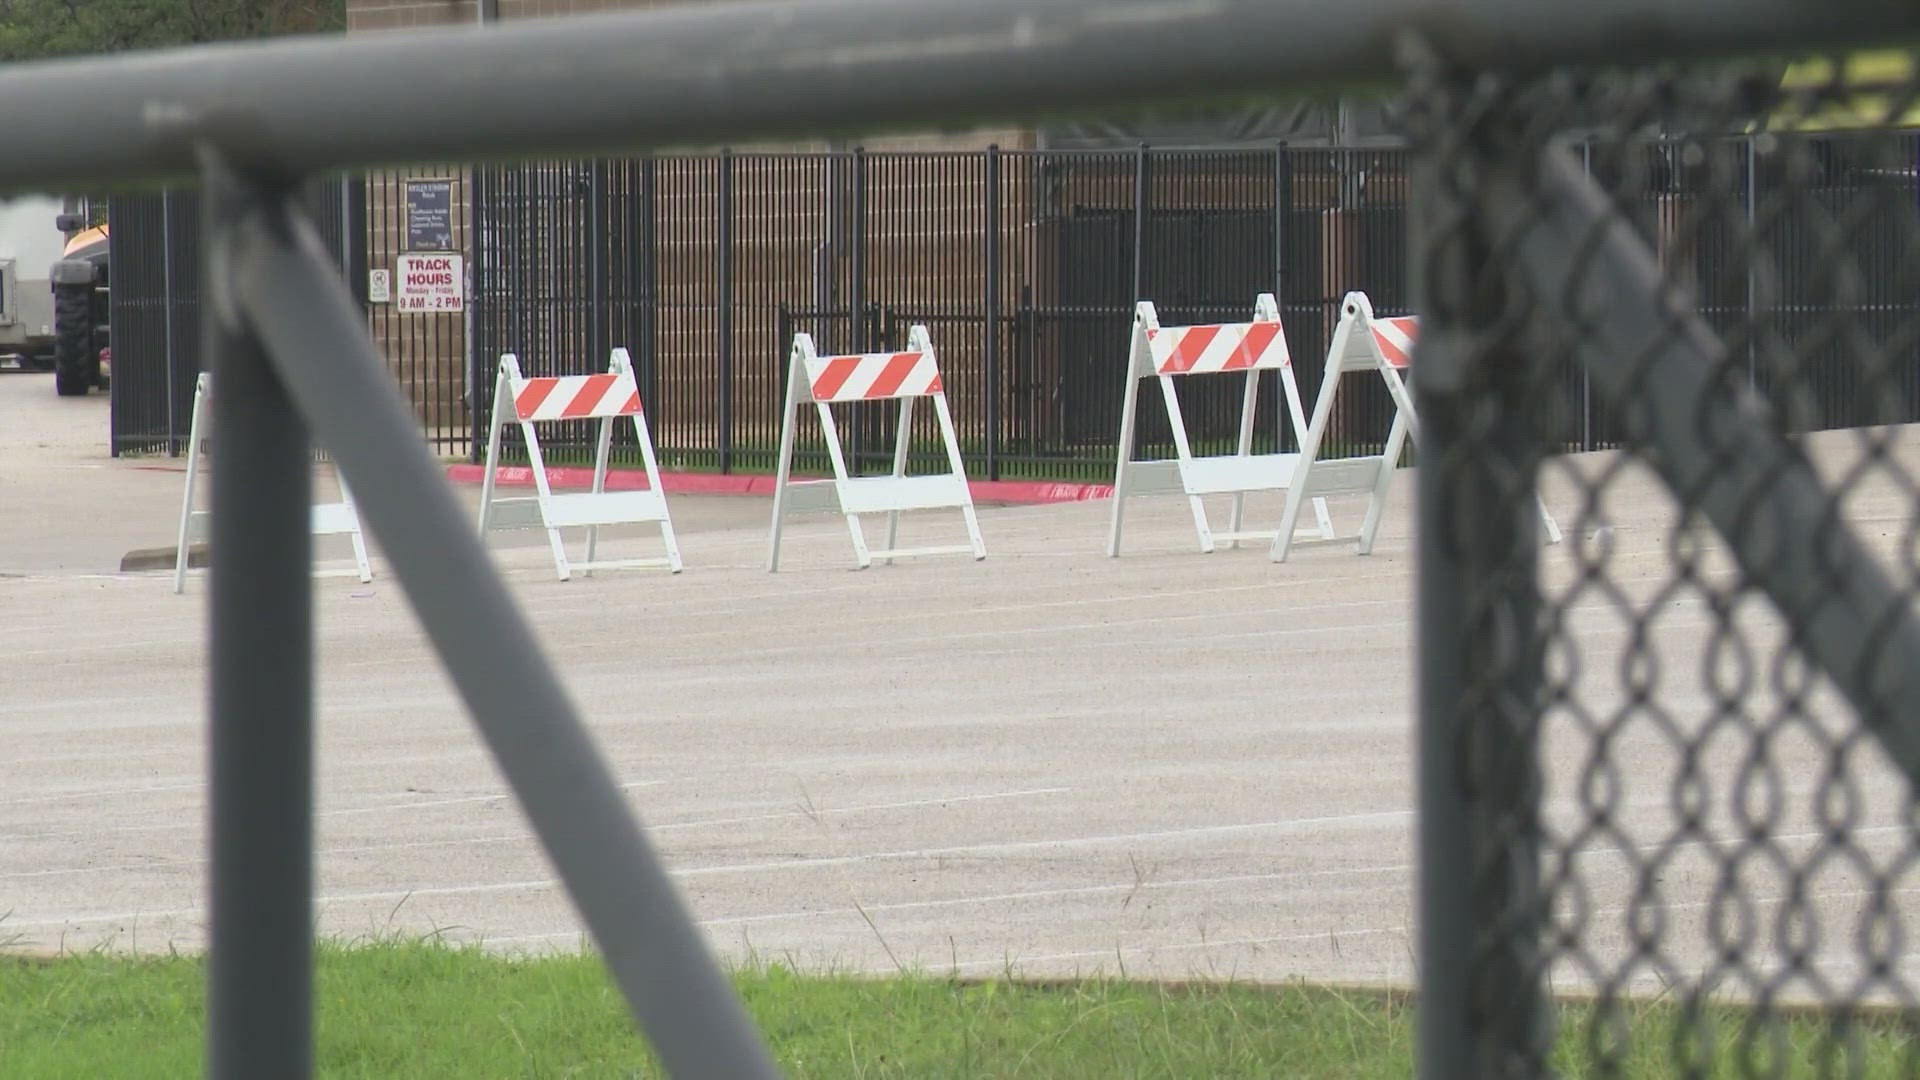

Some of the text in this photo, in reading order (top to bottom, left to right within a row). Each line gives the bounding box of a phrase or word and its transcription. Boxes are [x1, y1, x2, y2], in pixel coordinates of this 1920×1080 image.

[407, 259, 452, 271] TRACK
[407, 273, 452, 285] HOURS
[405, 287, 429, 295] Monday
[435, 287, 454, 295] Friday
[400, 297, 406, 308] 9
[409, 297, 425, 308] AM
[436, 297, 442, 308] 2
[445, 297, 461, 308] PM
